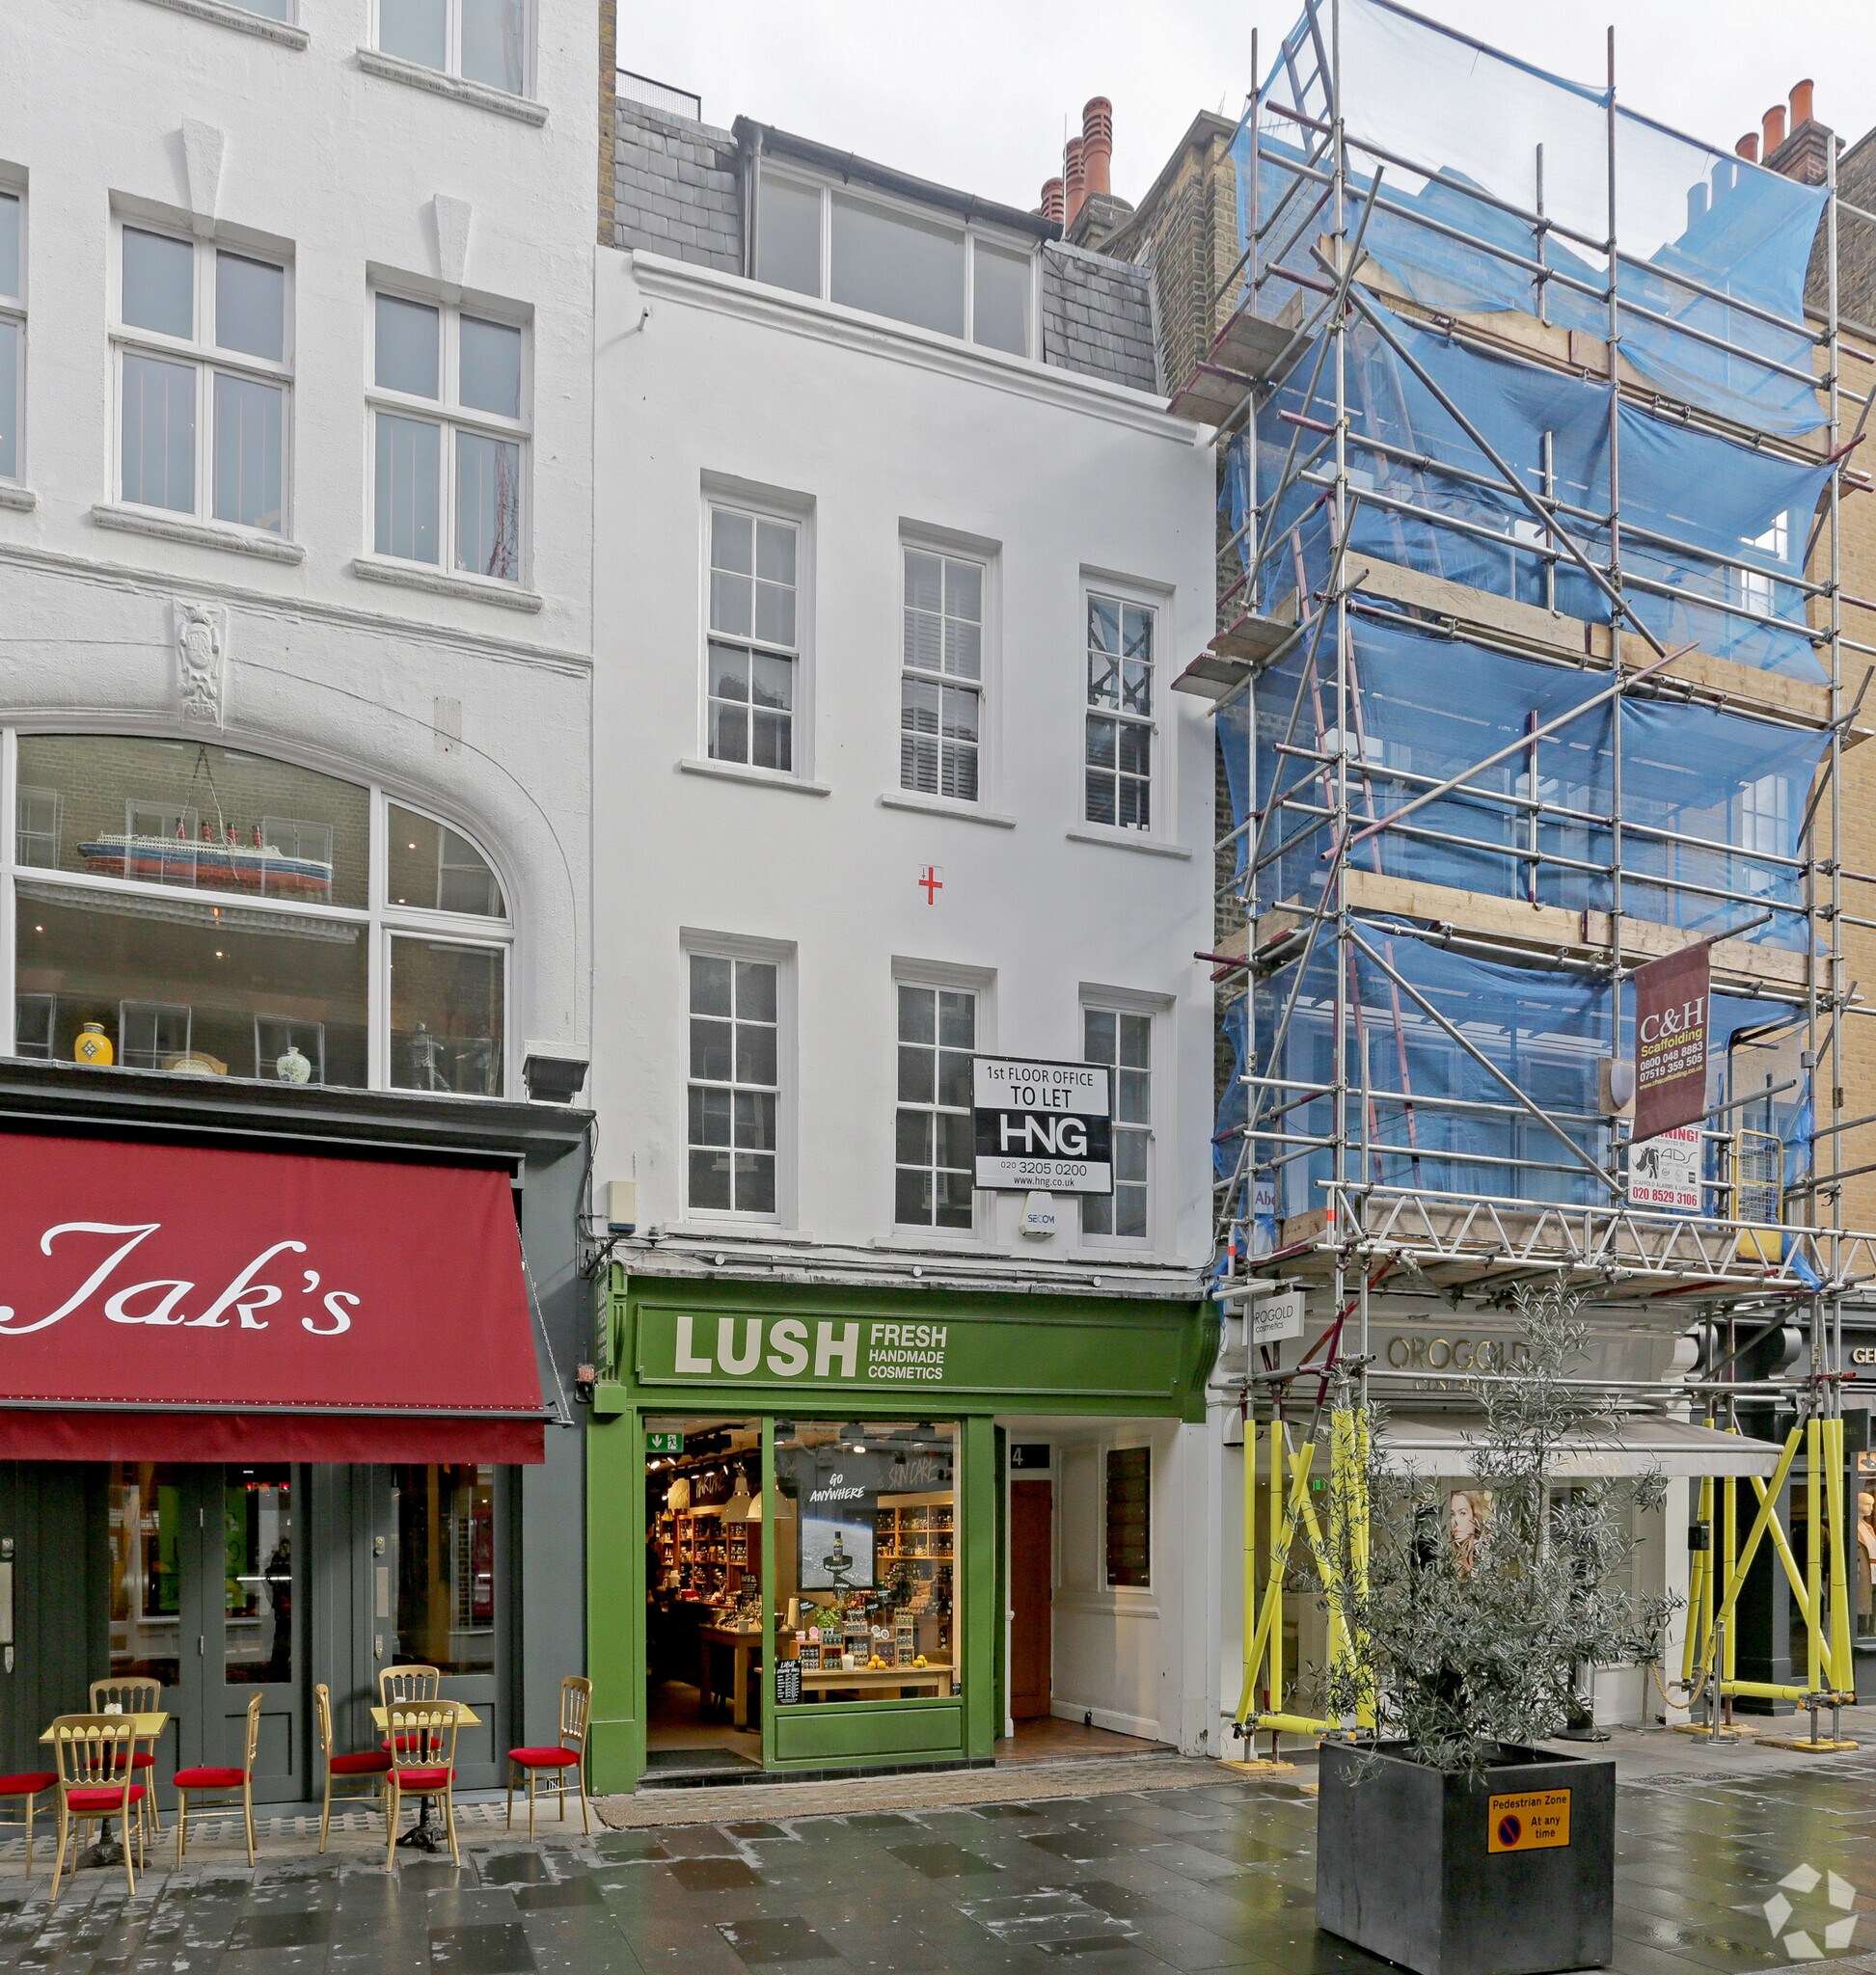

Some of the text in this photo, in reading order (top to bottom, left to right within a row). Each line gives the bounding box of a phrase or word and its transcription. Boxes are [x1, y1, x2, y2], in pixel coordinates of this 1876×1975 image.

[1640, 996, 1705, 1043] C&H
[1641, 1028, 1703, 1057] Scaffolding
[1640, 1042, 1703, 1071] 0800 048 8883
[987, 1066, 1094, 1086] 1st FLOOR OFFICE
[1640, 1053, 1703, 1082] 07519 359 505
[1011, 1086, 1073, 1108] TO LET
[1000, 1114, 1088, 1156] HNG
[1000, 1160, 1088, 1177] 020 3205 0200
[1014, 1176, 1074, 1187] www.hng.co.uk
[1632, 1186, 1698, 1206] 020 8529 3106
[1027, 1214, 1055, 1224] SECOM
[0, 1221, 361, 1335] Jak's
[1254, 1305, 1293, 1324] ROGOLD
[870, 1323, 947, 1348] FRESH
[1255, 1319, 1284, 1334] cosmetics
[675, 1315, 859, 1378] LUSH
[868, 1348, 944, 1365] HANDMADE
[867, 1365, 943, 1380] COSMETICS
[829, 1473, 844, 1487] GO
[809, 1485, 866, 1502] ANYWHERE
[1492, 1795, 1567, 1810] Pedestrian Zone
[1531, 1815, 1561, 1826] At any
[1535, 1827, 1556, 1839] time
